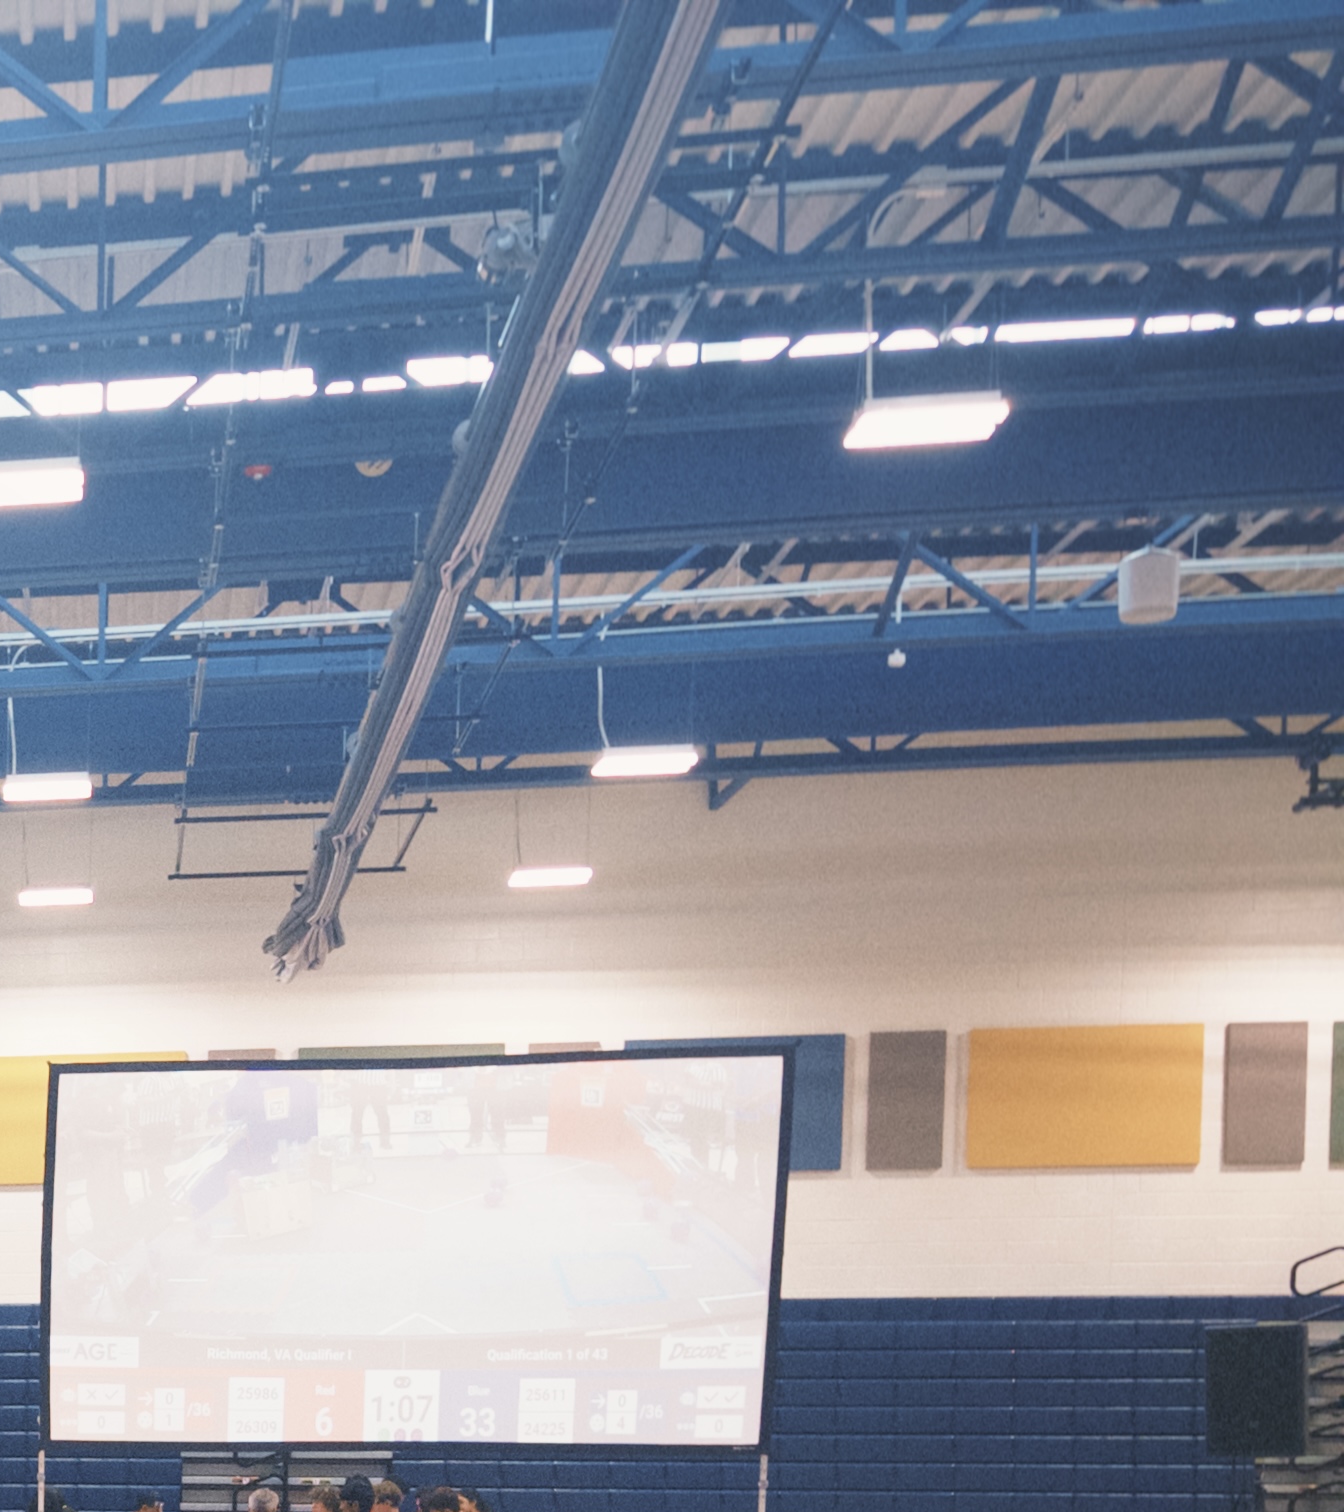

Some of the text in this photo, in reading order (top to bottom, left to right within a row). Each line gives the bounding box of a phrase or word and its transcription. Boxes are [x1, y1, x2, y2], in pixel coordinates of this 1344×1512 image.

[73, 1343, 117, 1361] AGE
[207, 1347, 271, 1362] Richmond,
[274, 1348, 291, 1360] VA
[294, 1348, 345, 1362] Qualifier
[487, 1349, 608, 1363] Qualification 1 of 43
[237, 1387, 278, 1401] 25986
[315, 1384, 335, 1396] Red
[525, 1388, 566, 1401] 25611
[187, 1402, 211, 1417] /36
[371, 1394, 433, 1423] 1:07
[639, 1404, 664, 1419] /36
[236, 1421, 277, 1434] 26309
[314, 1407, 333, 1436] 6
[459, 1407, 496, 1437] 33
[524, 1423, 565, 1437] 24225
